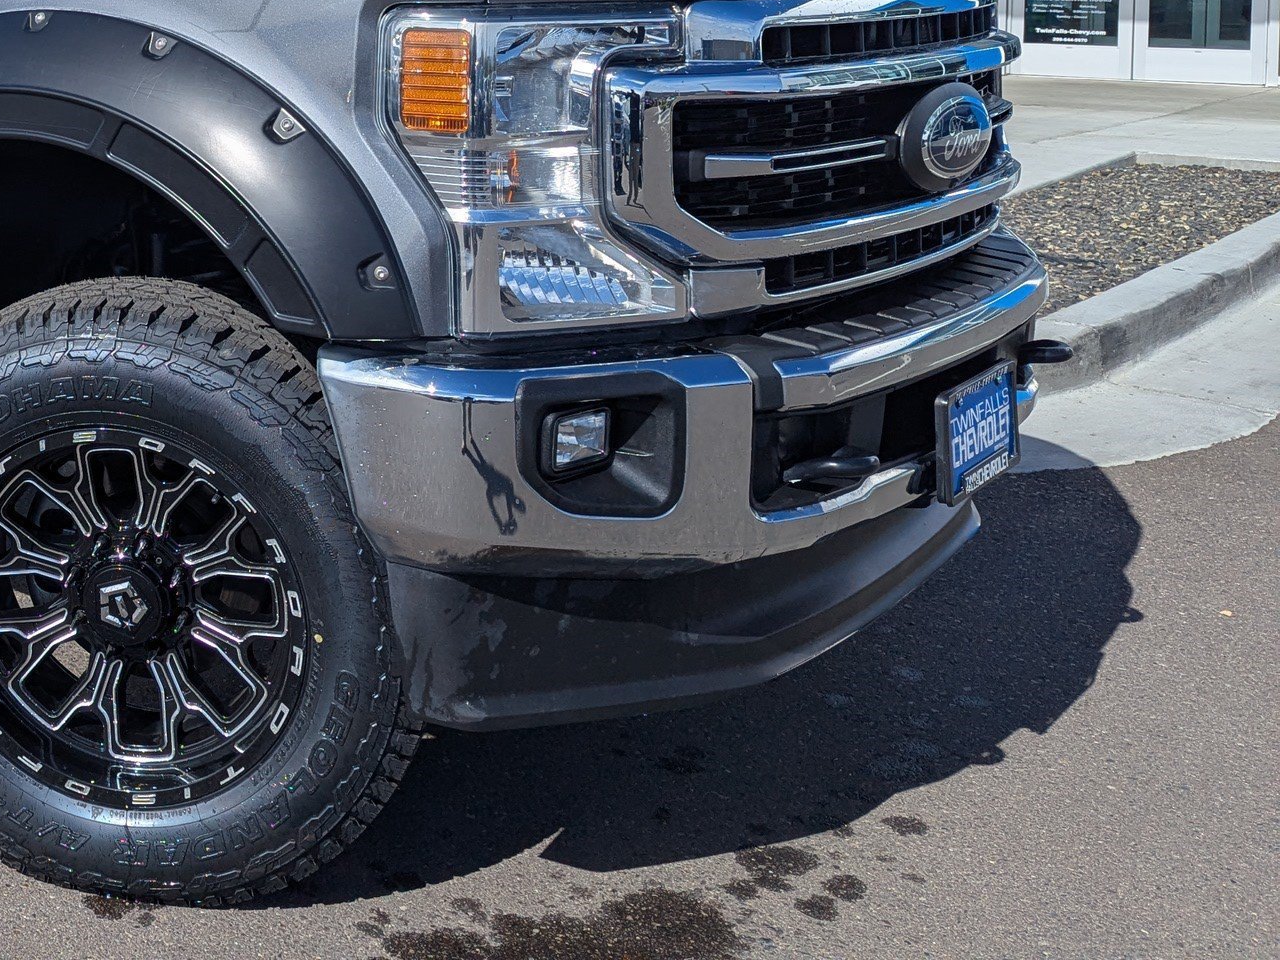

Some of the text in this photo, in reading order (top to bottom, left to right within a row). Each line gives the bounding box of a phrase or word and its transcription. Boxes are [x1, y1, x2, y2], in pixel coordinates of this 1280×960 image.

[943, 114, 982, 161] Ford
[950, 387, 1010, 437] TWINFALLS
[951, 404, 1010, 469] CHEVROLET
[978, 451, 1009, 485] CHEVROLET
[112, 670, 360, 867] GEOLANDAR
